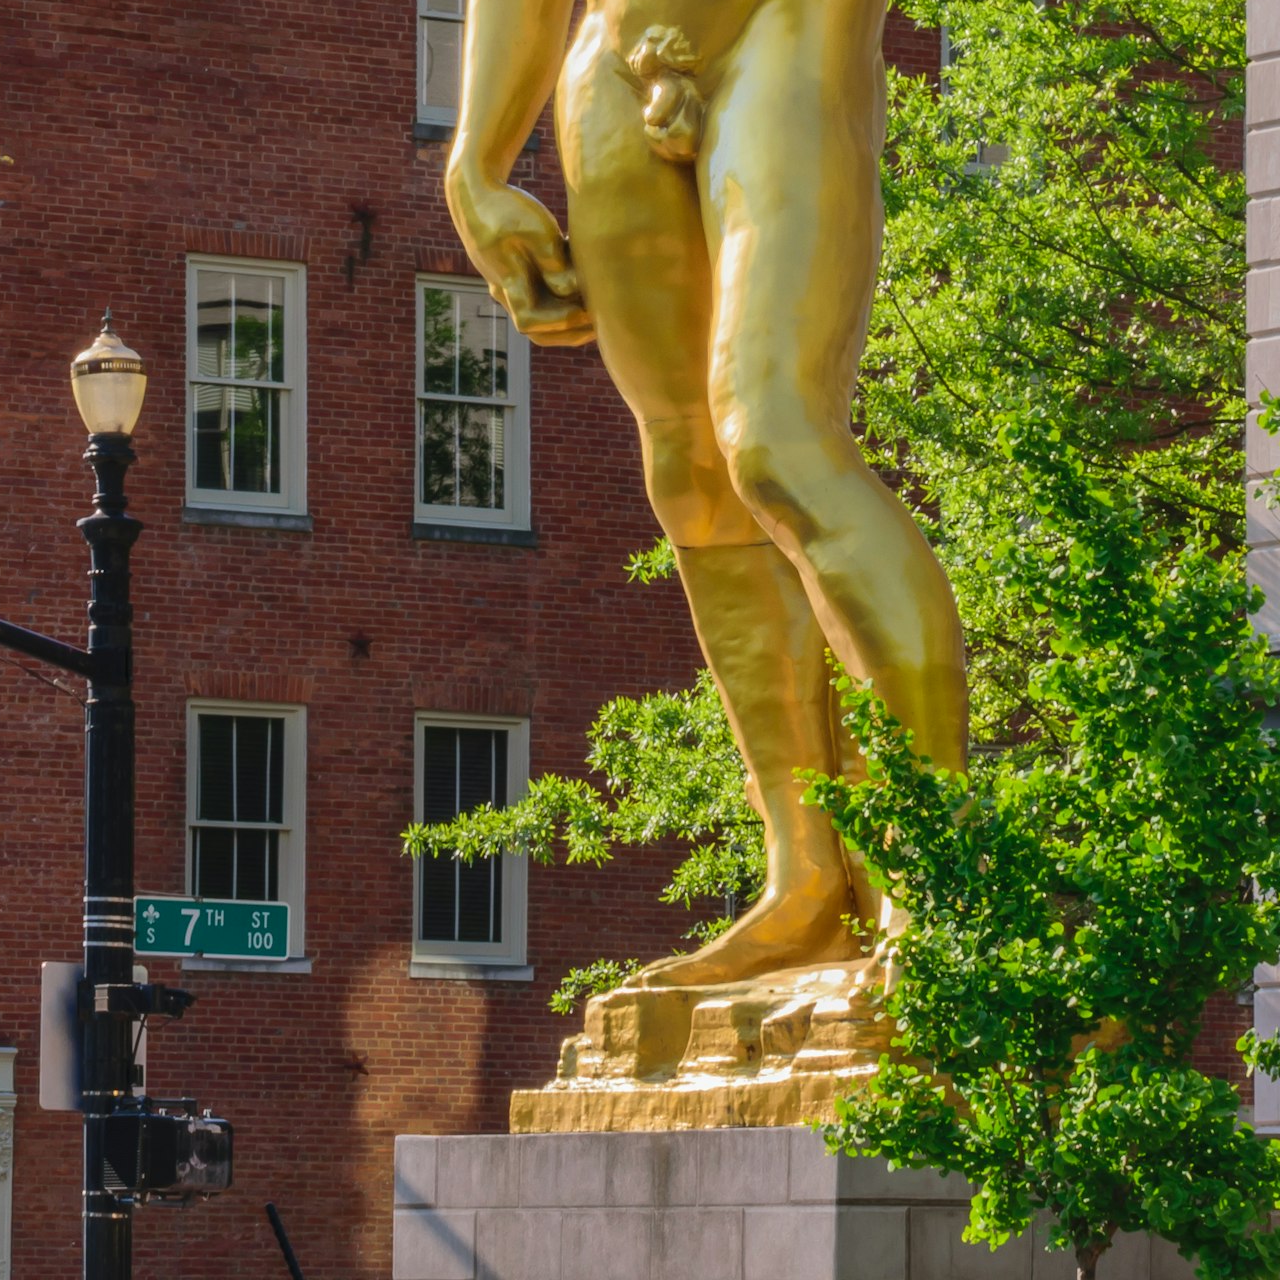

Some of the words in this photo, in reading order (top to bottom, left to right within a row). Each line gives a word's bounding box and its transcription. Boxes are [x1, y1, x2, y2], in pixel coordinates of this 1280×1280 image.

[146, 928, 156, 944] S
[251, 911, 271, 929] ST
[247, 932, 274, 950] 100
